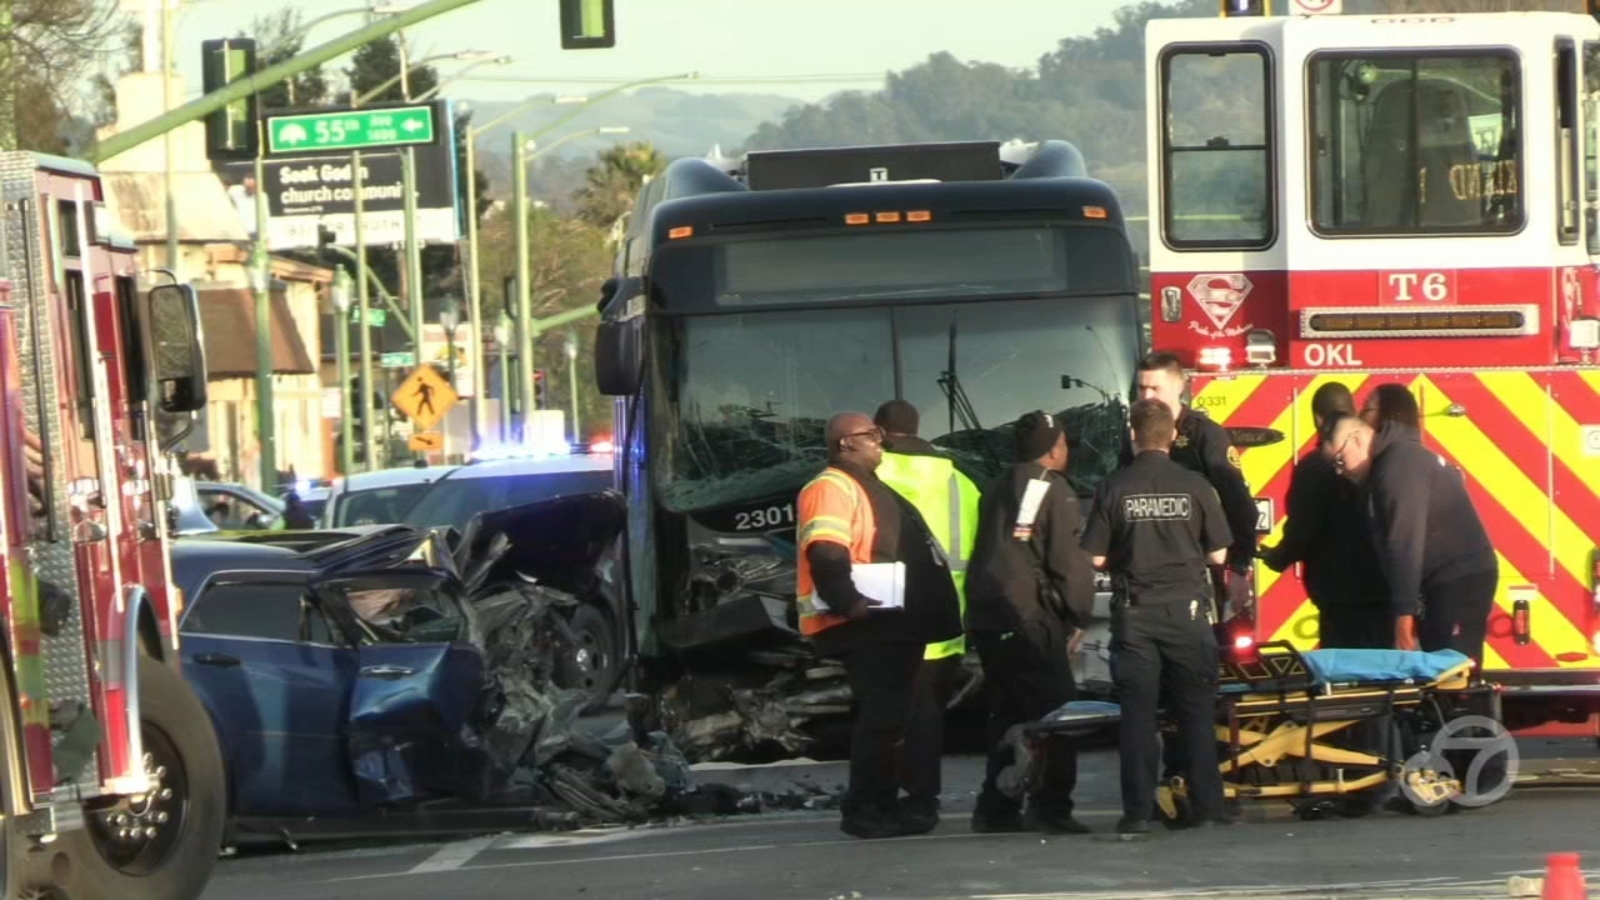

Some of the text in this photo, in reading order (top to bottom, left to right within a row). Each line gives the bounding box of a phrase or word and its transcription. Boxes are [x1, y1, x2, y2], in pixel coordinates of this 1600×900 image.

[280, 165, 319, 184] Seek
[320, 163, 352, 181] God
[281, 186, 332, 204] church
[1304, 343, 1363, 366] OKL
[735, 503, 794, 529] 2301
[1125, 497, 1189, 517] PARAMEDIC
